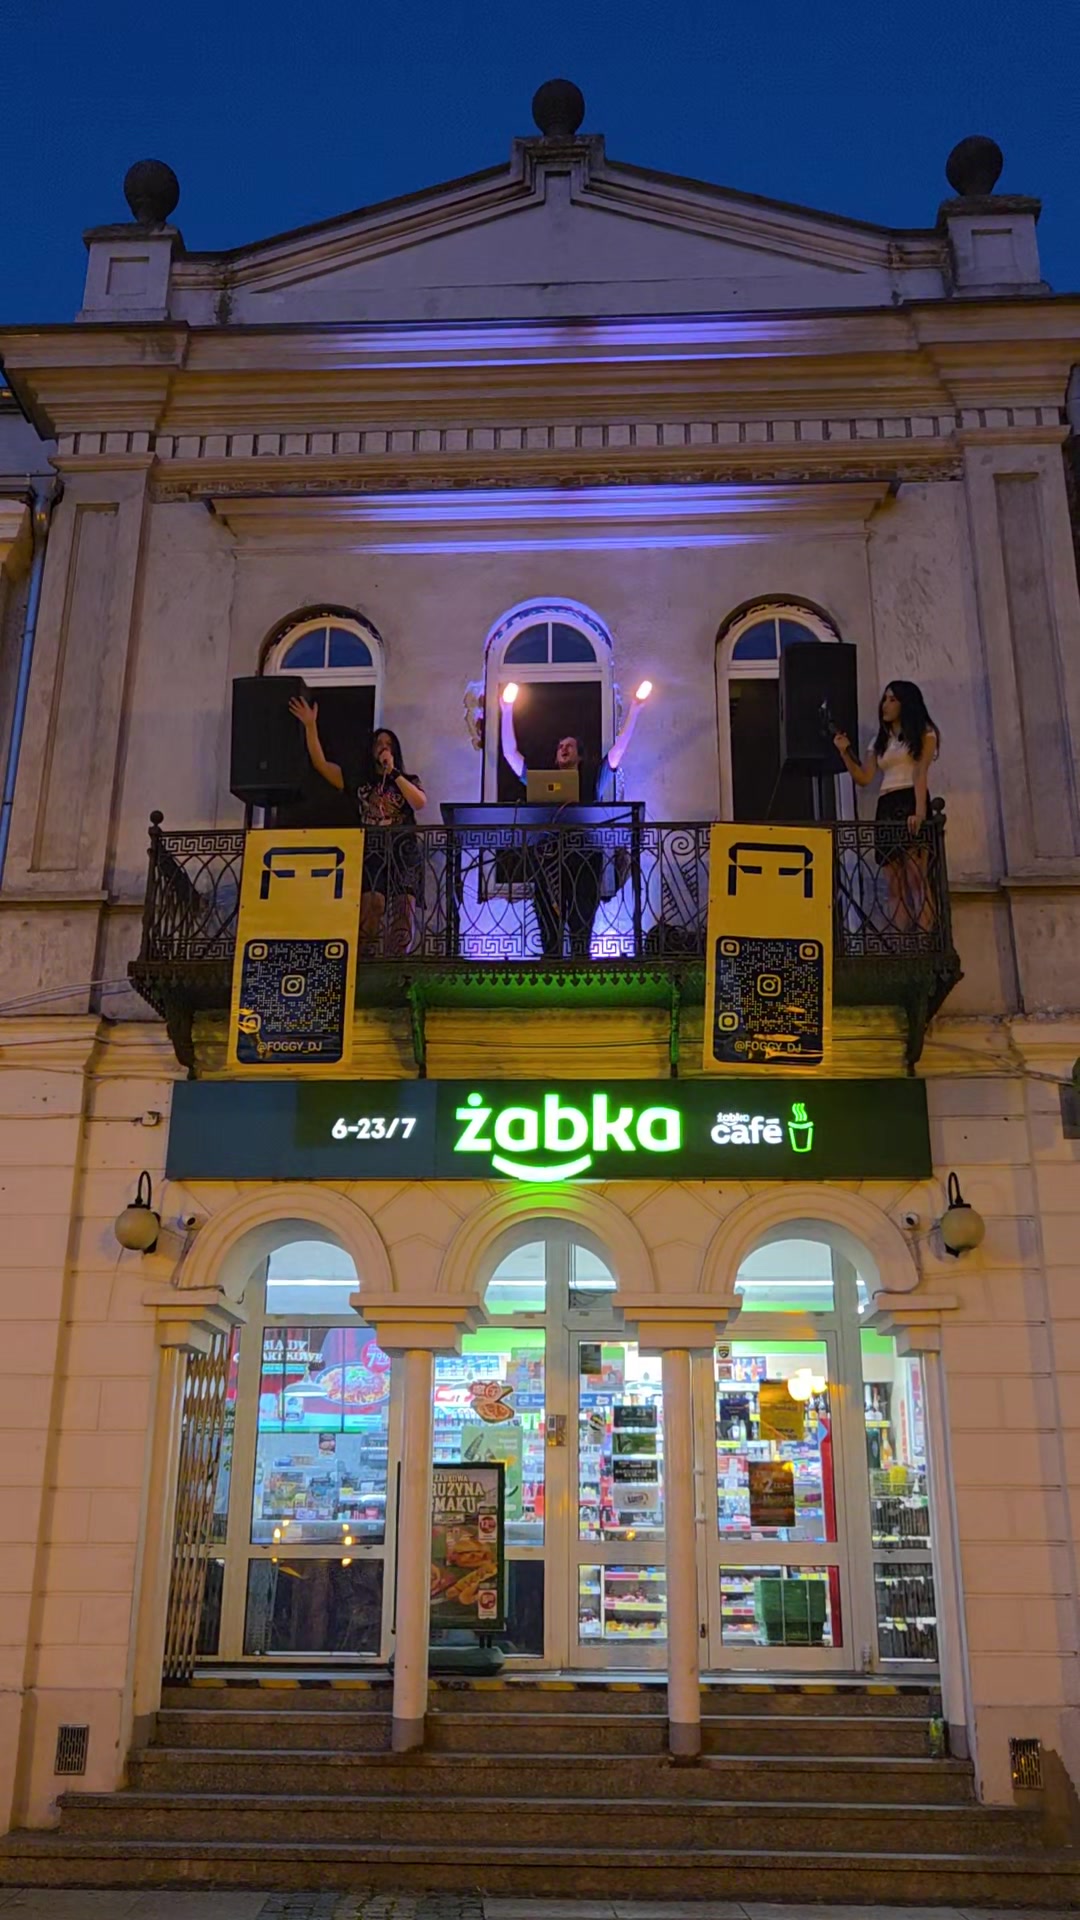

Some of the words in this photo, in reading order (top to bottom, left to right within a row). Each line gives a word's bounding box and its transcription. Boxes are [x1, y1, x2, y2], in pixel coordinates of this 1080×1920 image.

[257, 1041, 323, 1053] @FOGGY_DJ
[734, 1041, 802, 1053] @FOGGYDJ
[331, 1118, 417, 1139] 6-23/7
[453, 1092, 682, 1152] żabka
[432, 1480, 485, 1496] RUŻYNA
[432, 1497, 477, 1513] MAKU
